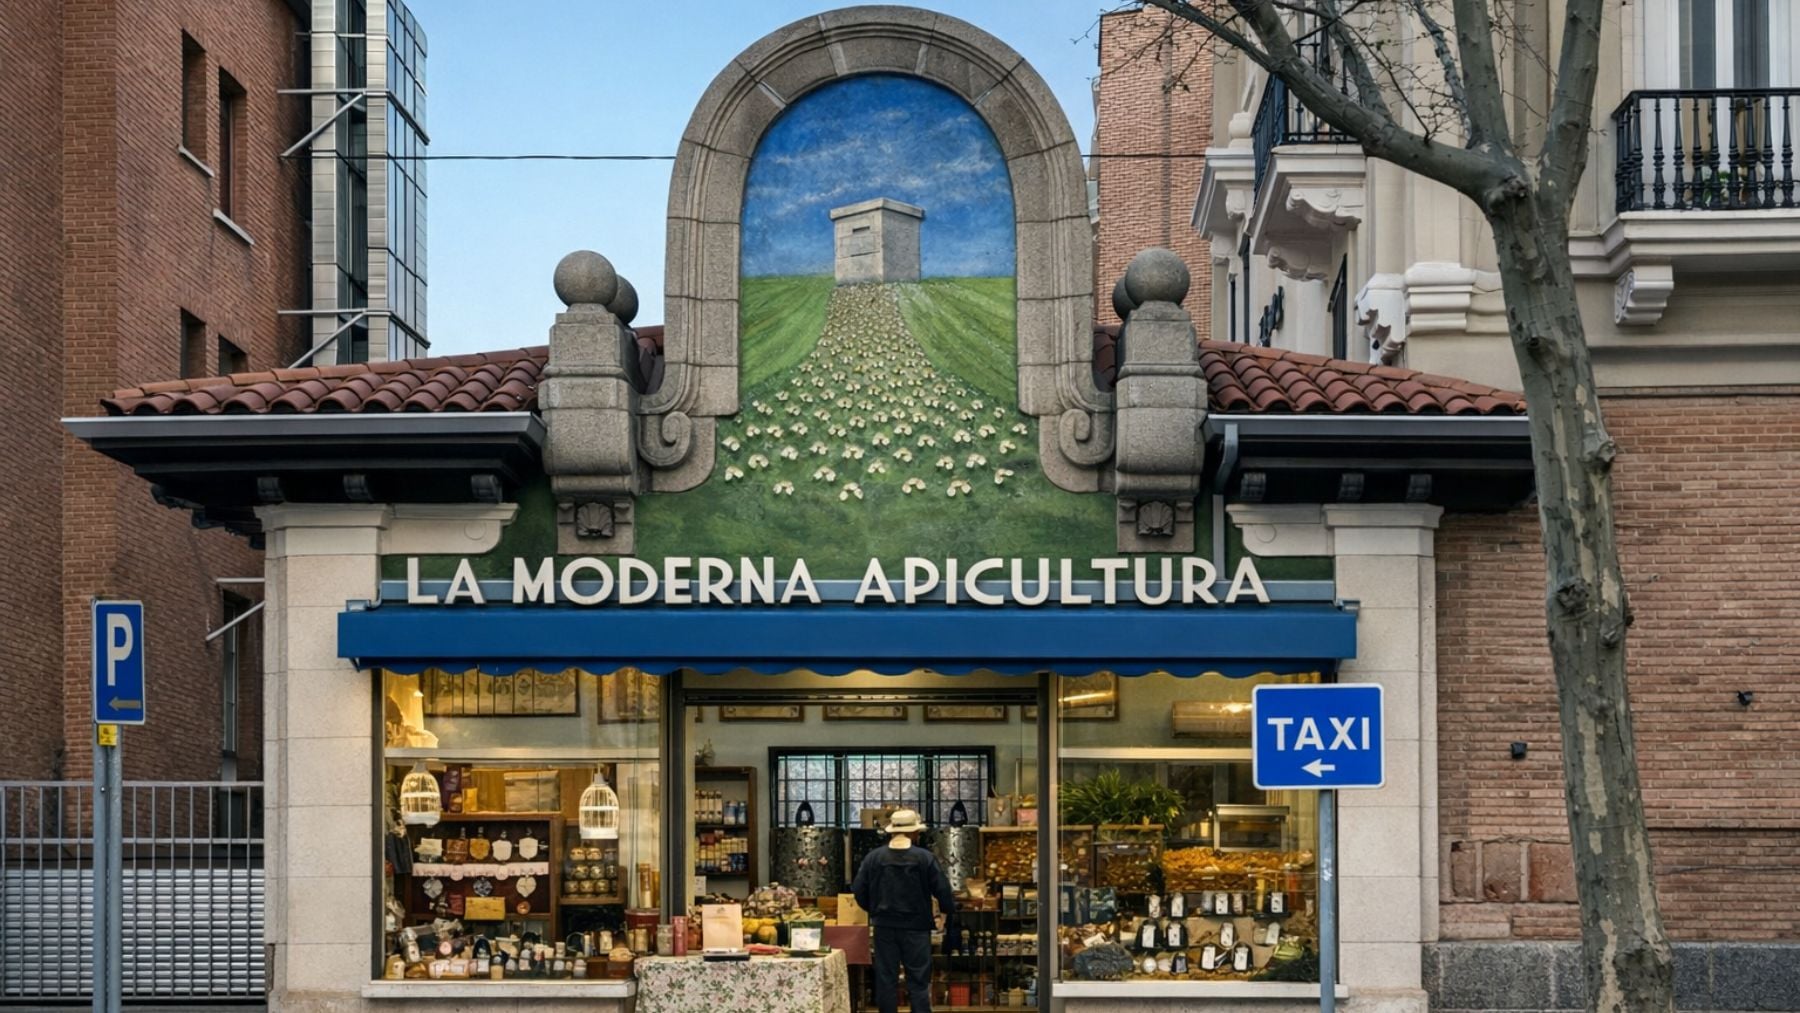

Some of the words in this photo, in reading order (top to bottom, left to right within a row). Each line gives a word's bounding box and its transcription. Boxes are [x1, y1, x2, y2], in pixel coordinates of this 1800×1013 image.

[407, 557, 486, 605] LA
[512, 556, 822, 605] MODERNA
[853, 557, 1271, 605] APICULTURA
[107, 613, 134, 687] P
[1267, 716, 1371, 751] TAXI
